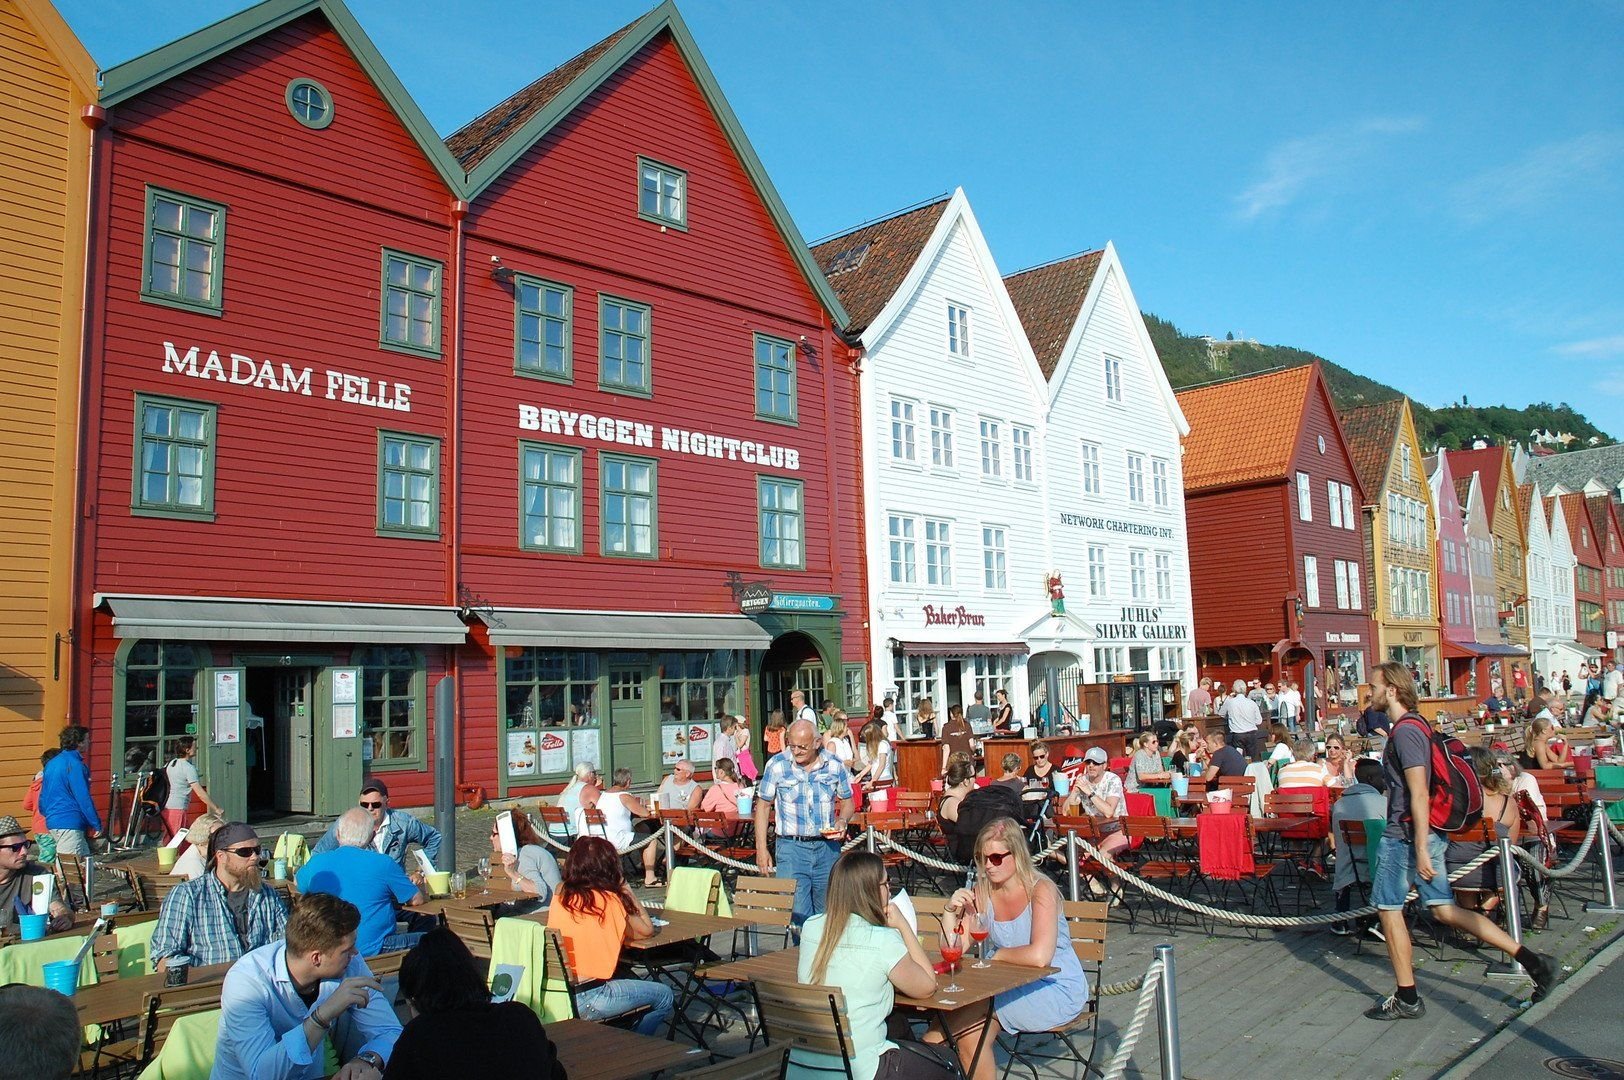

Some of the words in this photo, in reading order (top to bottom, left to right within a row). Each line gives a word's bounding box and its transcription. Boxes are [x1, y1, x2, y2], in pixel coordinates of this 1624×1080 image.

[161, 341, 313, 396] MADAM
[325, 369, 412, 412] FELLE
[518, 404, 654, 448] BRYGGEN
[661, 428, 800, 470] NIGHTCLUB
[1060, 513, 1105, 530] NETWORK
[1106, 520, 1158, 537] CHARTERING
[1159, 527, 1175, 539] INT.
[741, 597, 769, 608] BRYGGEN
[922, 604, 957, 628] Baker
[955, 605, 985, 628] Brun
[1095, 622, 1137, 639] SILVER
[1142, 624, 1188, 639] GALLERY
[279, 655, 291, 666] 43
[544, 739, 564, 749] Felle
[1061, 757, 1082, 768] Madam
